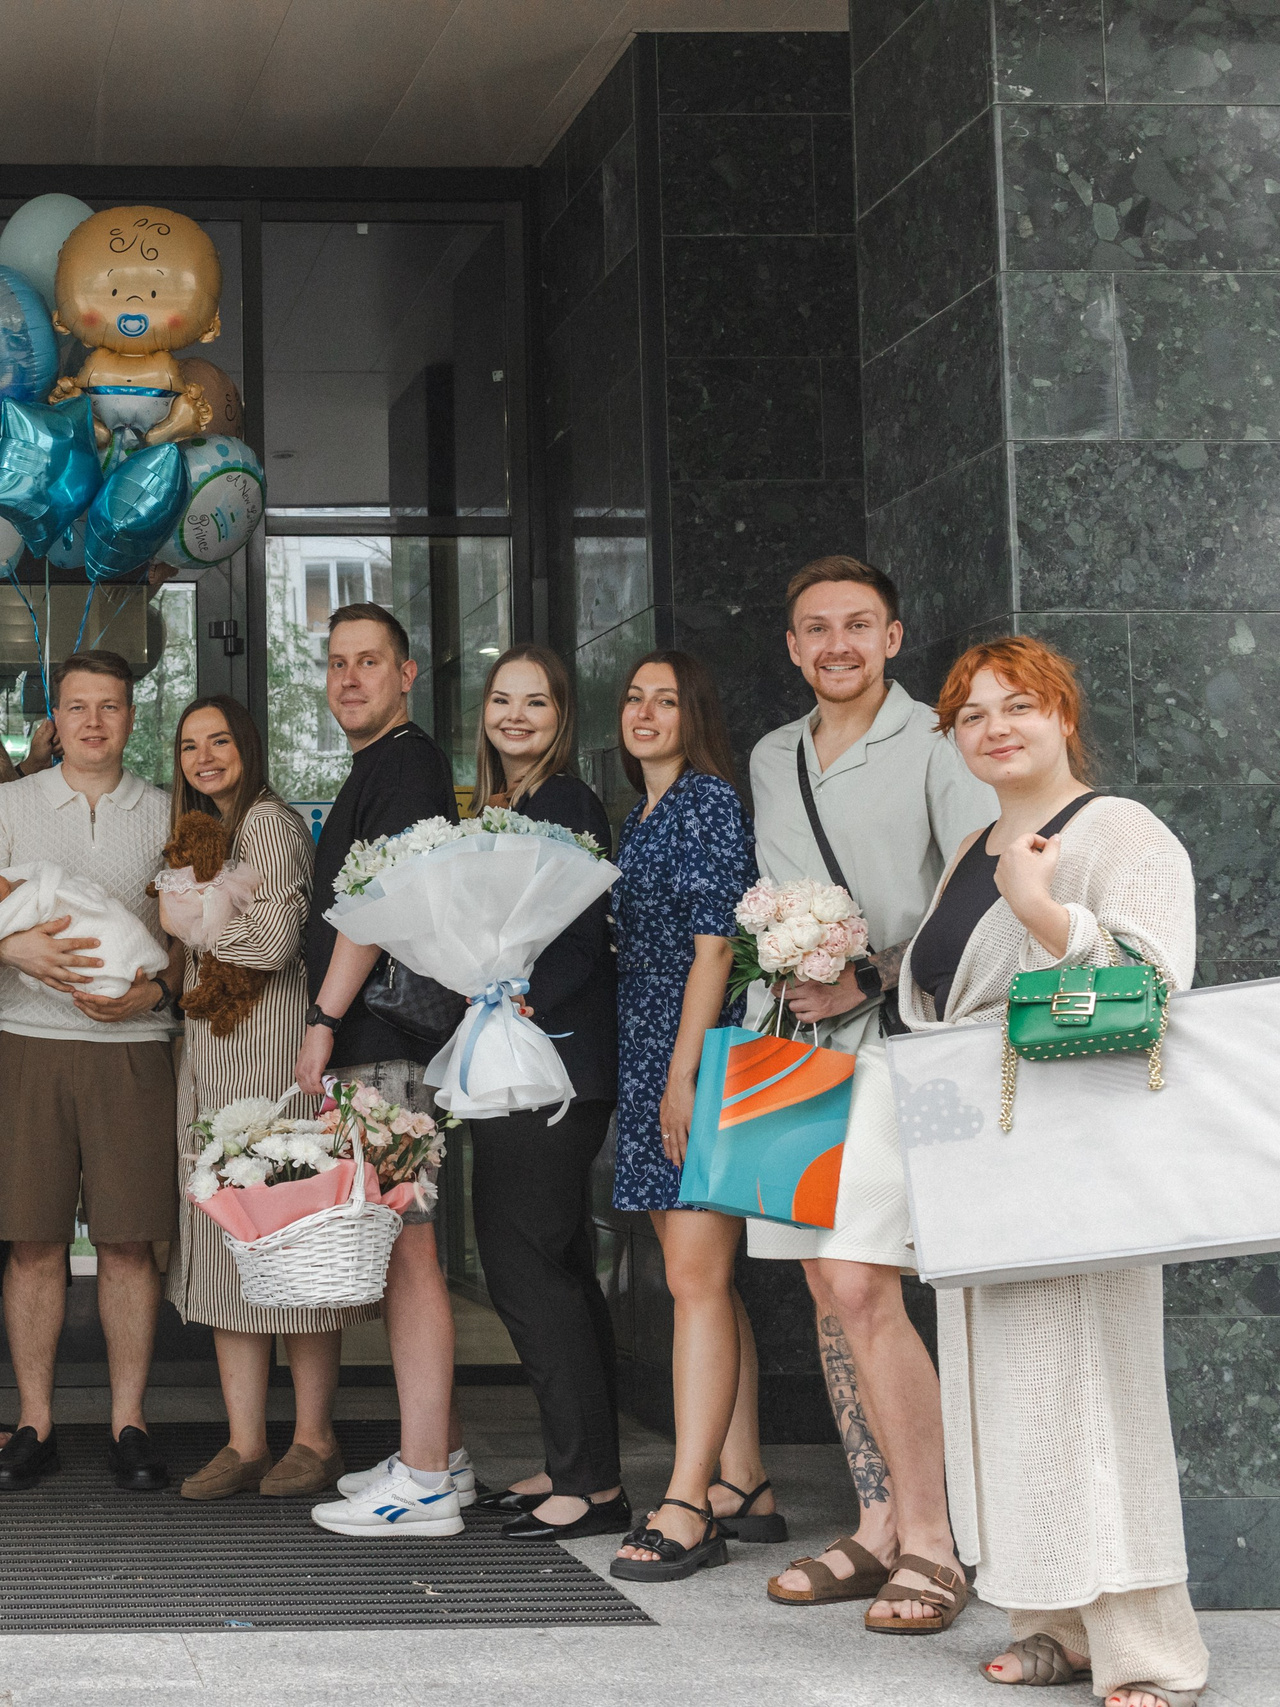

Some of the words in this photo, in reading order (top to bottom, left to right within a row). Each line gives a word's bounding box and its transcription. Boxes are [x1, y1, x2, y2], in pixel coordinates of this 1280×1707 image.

[226, 475, 241, 487] A
[238, 479, 251, 506] New
[187, 514, 210, 554] Prince
[391, 1493, 416, 1508] Reebok
